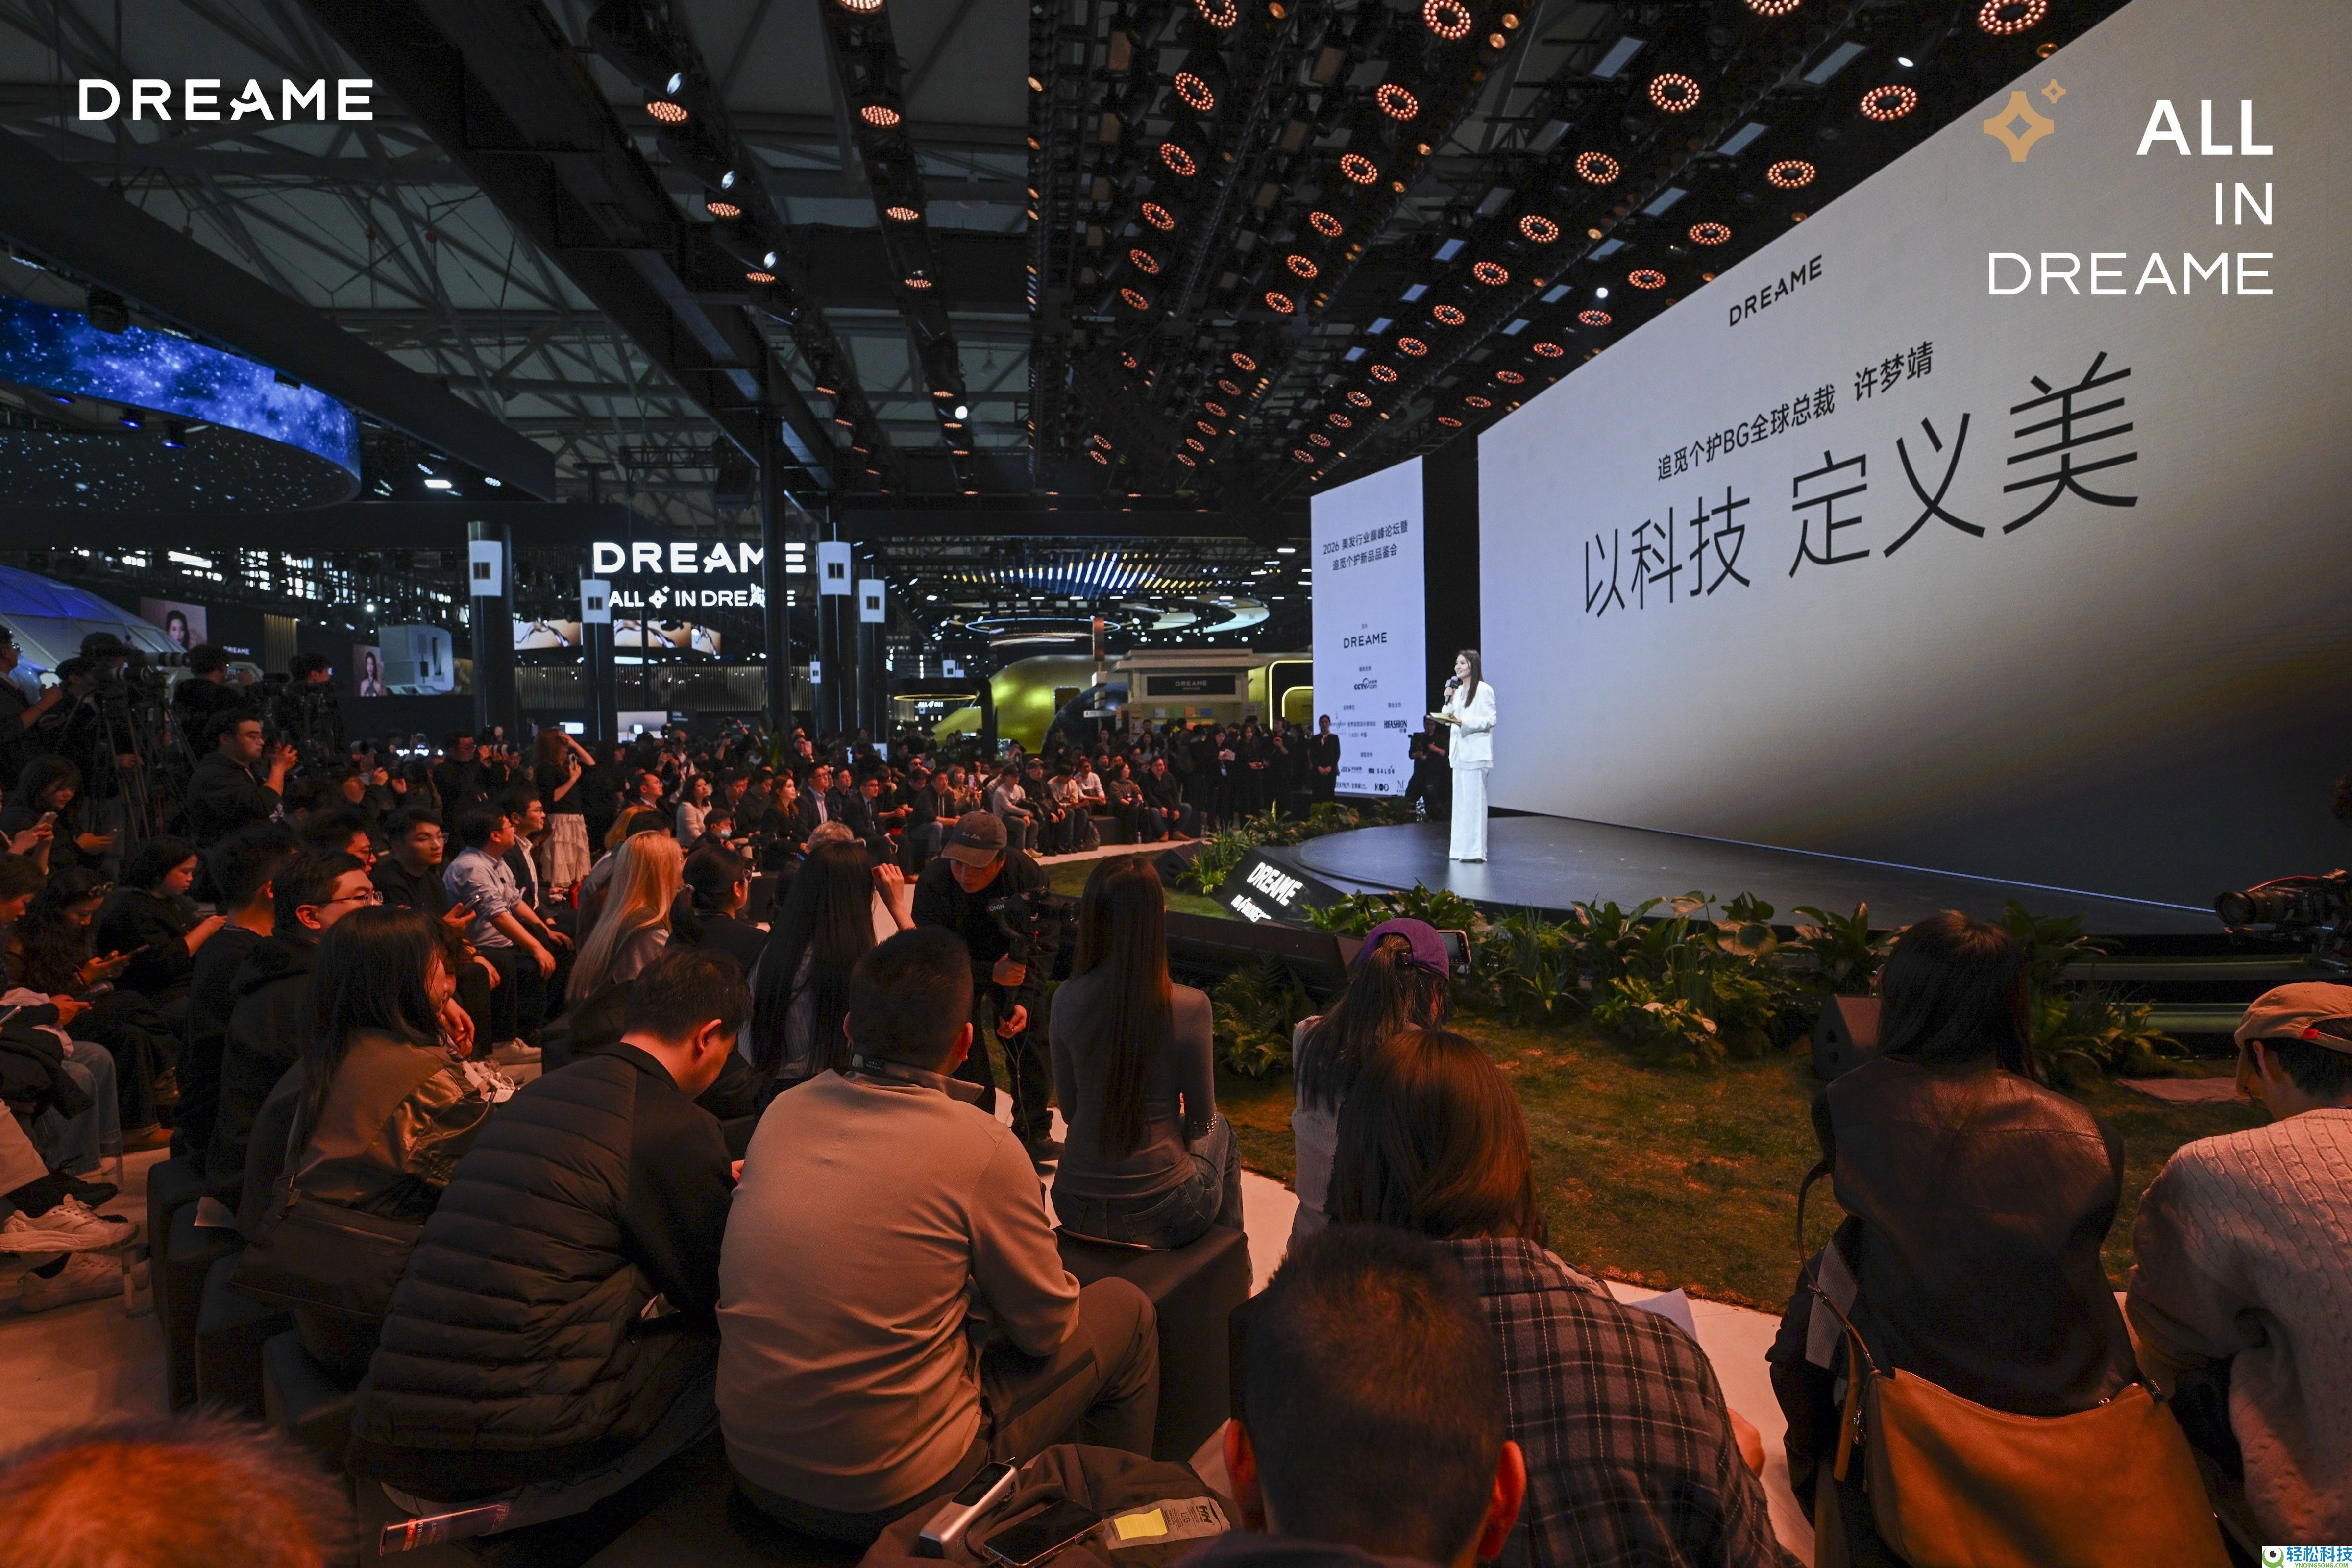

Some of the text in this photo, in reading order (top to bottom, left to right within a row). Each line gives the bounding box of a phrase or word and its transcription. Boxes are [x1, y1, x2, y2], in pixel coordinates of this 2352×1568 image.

[1729, 254, 1824, 326] DREAME
[1657, 341, 1934, 482] 追觅个护BG全球总裁 许梦靖
[1584, 350, 2139, 618] 以科技 定义美
[593, 542, 806, 573] DREAME
[1323, 541, 1340, 555] 2026
[1333, 543, 1397, 571] 追觅个护新品品鉴会
[609, 590, 644, 607] ALL
[675, 590, 696, 607] IN
[701, 590, 796, 607] DREAE
[1344, 632, 1388, 649] DREAME
[1247, 862, 1303, 906] DREAME
